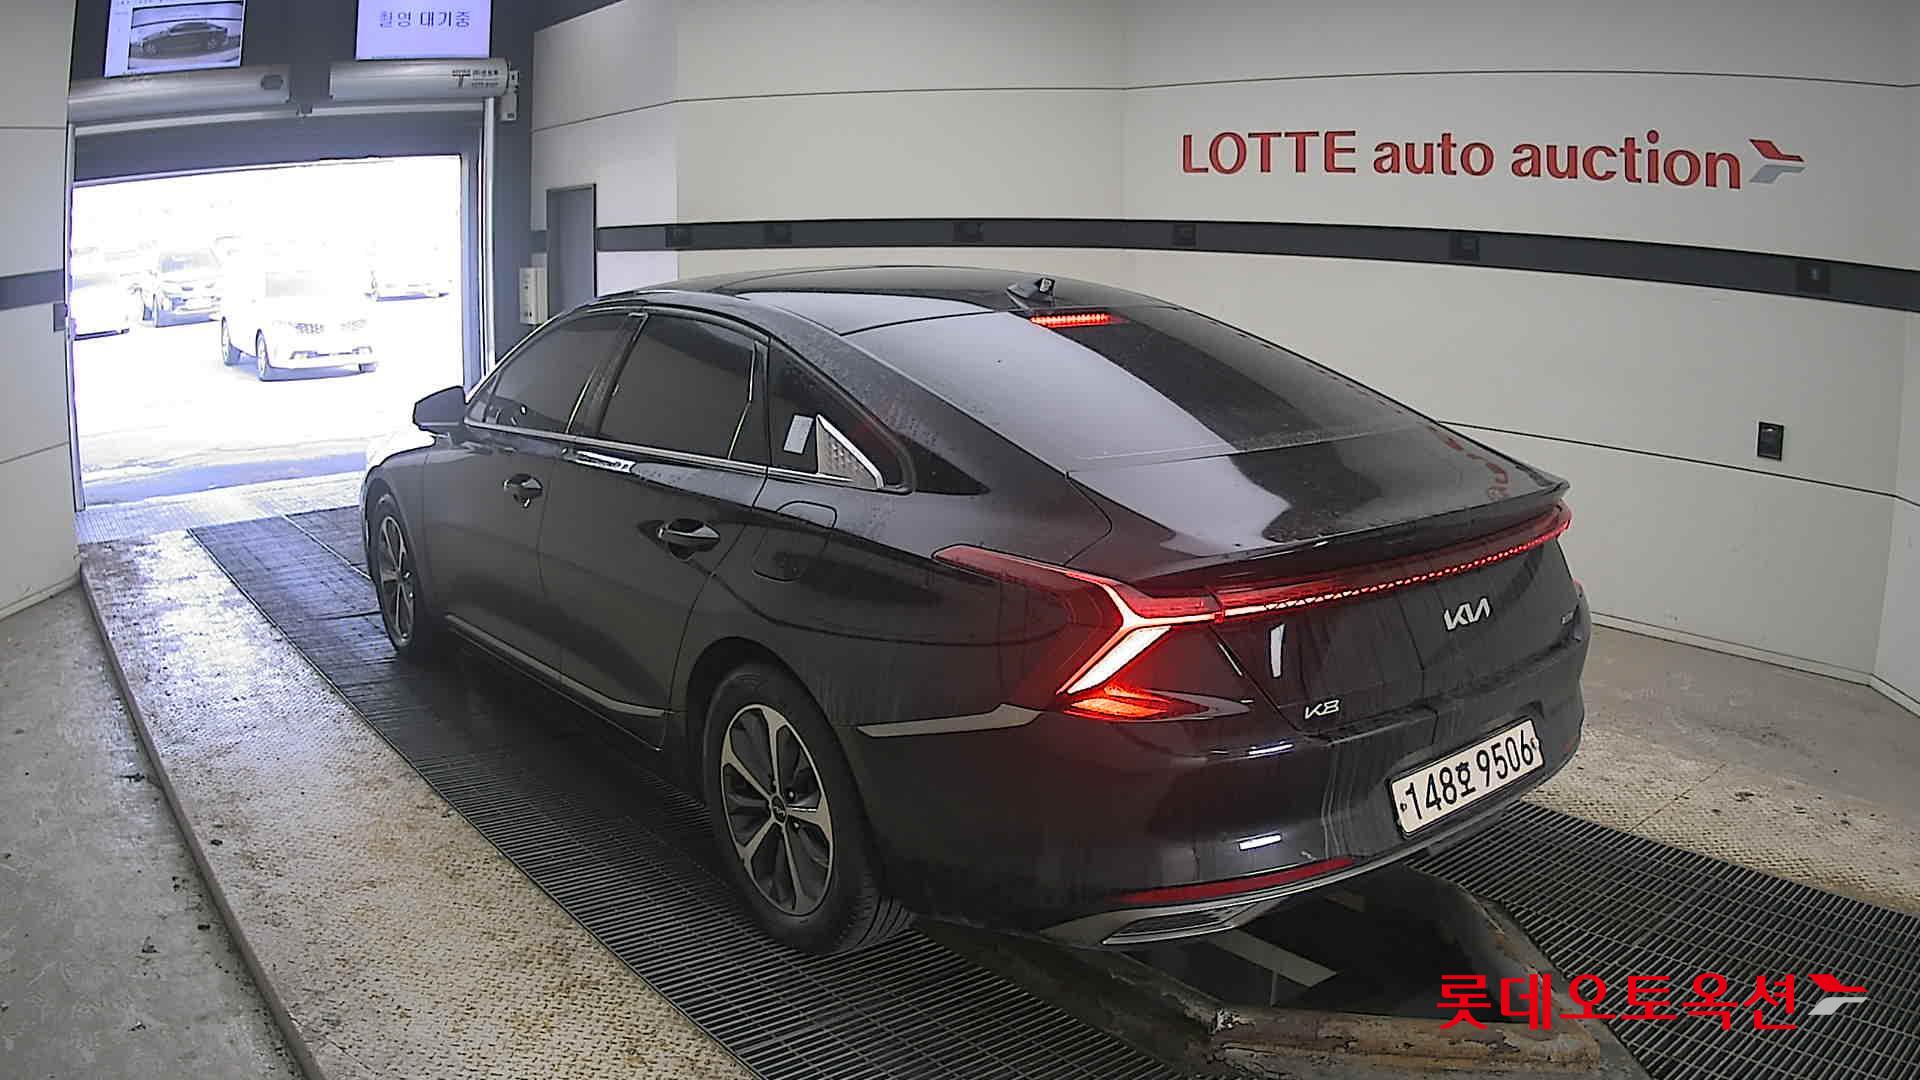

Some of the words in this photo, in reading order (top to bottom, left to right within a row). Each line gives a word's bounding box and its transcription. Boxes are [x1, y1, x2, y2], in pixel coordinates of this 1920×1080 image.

[419, 10, 471, 28] 대기중
[1182, 130, 1357, 175] LOTTE
[1373, 132, 1494, 177] auto
[1511, 129, 1741, 190] auction
[1443, 597, 1491, 631] KIA
[1304, 699, 1340, 720] K8
[1405, 761, 1477, 820] 148호
[1476, 729, 1535, 788] 9506
